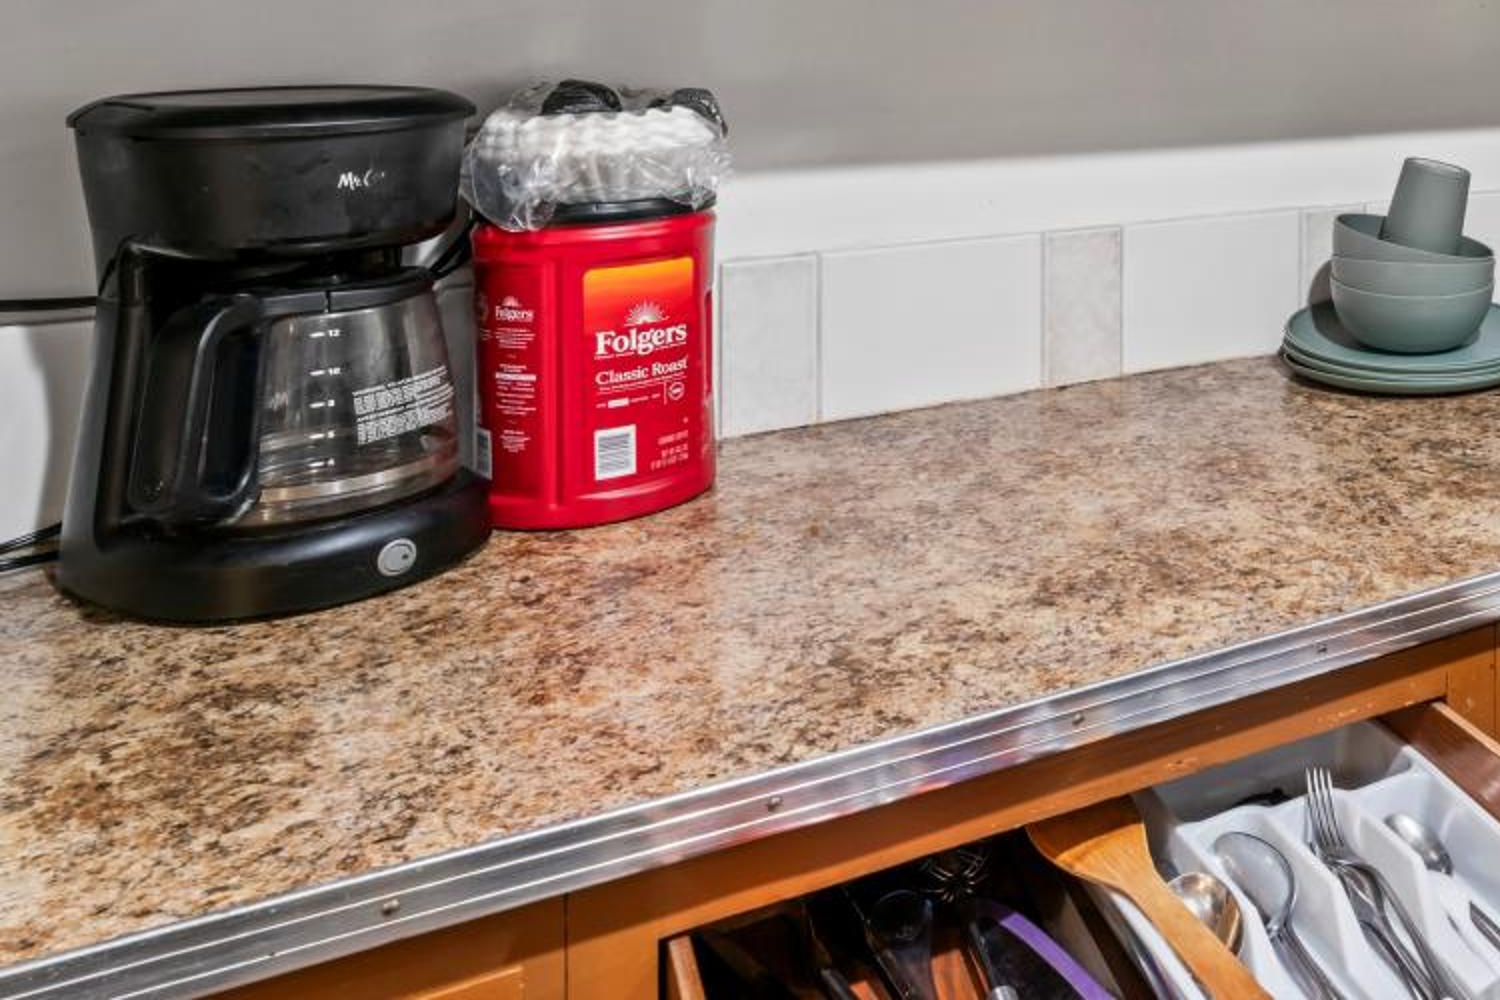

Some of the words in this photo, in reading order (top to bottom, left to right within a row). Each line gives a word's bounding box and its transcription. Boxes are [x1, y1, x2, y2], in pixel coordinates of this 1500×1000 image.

[595, 323, 688, 355] Folgers
[594, 366, 649, 385] Classic
[652, 355, 688, 376] Roast
